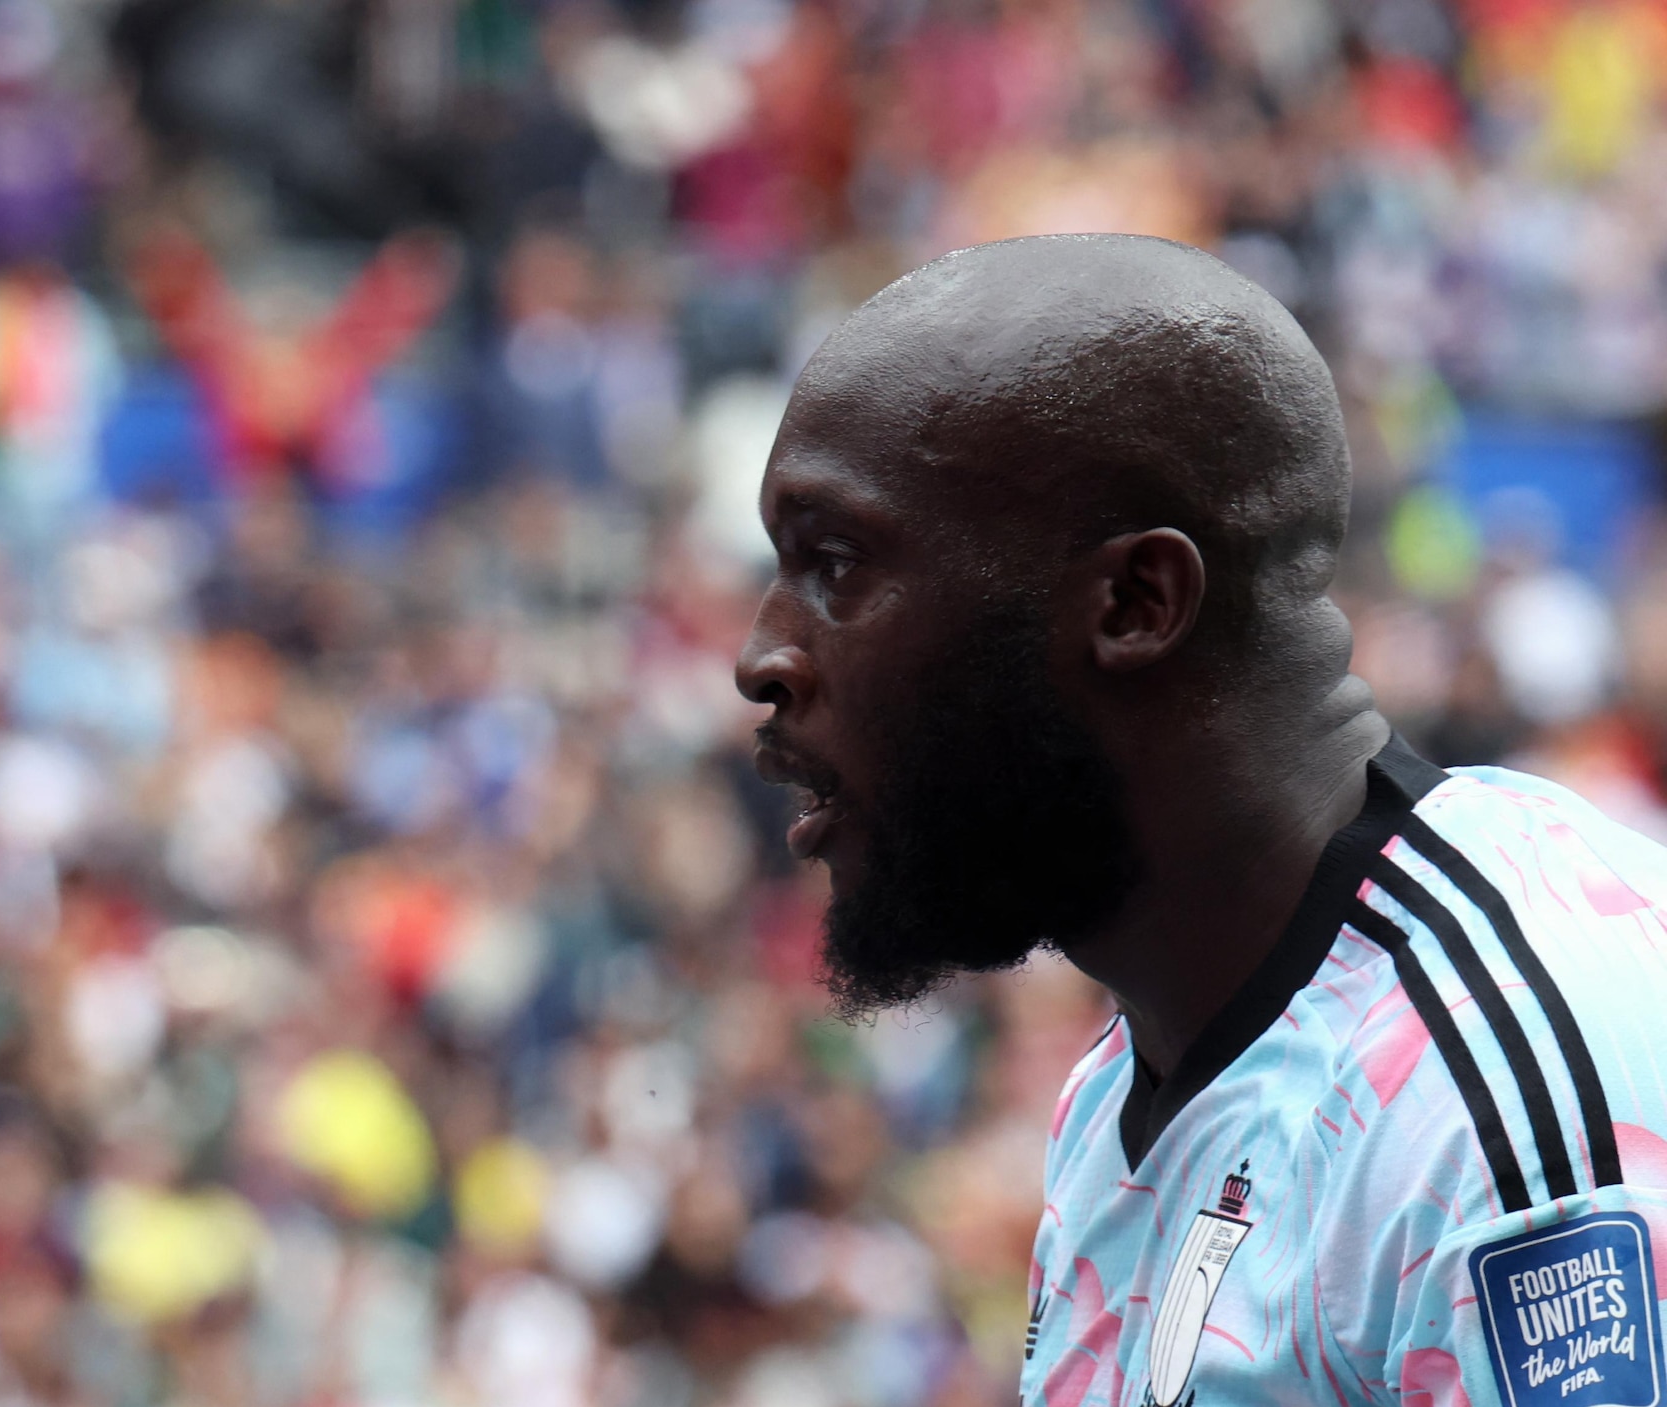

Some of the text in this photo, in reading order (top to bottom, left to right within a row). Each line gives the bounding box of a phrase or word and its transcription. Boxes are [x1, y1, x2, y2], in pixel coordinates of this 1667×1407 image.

[1508, 1246, 1623, 1304] FOOTBALL
[1516, 1278, 1627, 1346] UNITES
[1520, 1320, 1636, 1387] the World
[1561, 1366, 1601, 1397] FIFA
